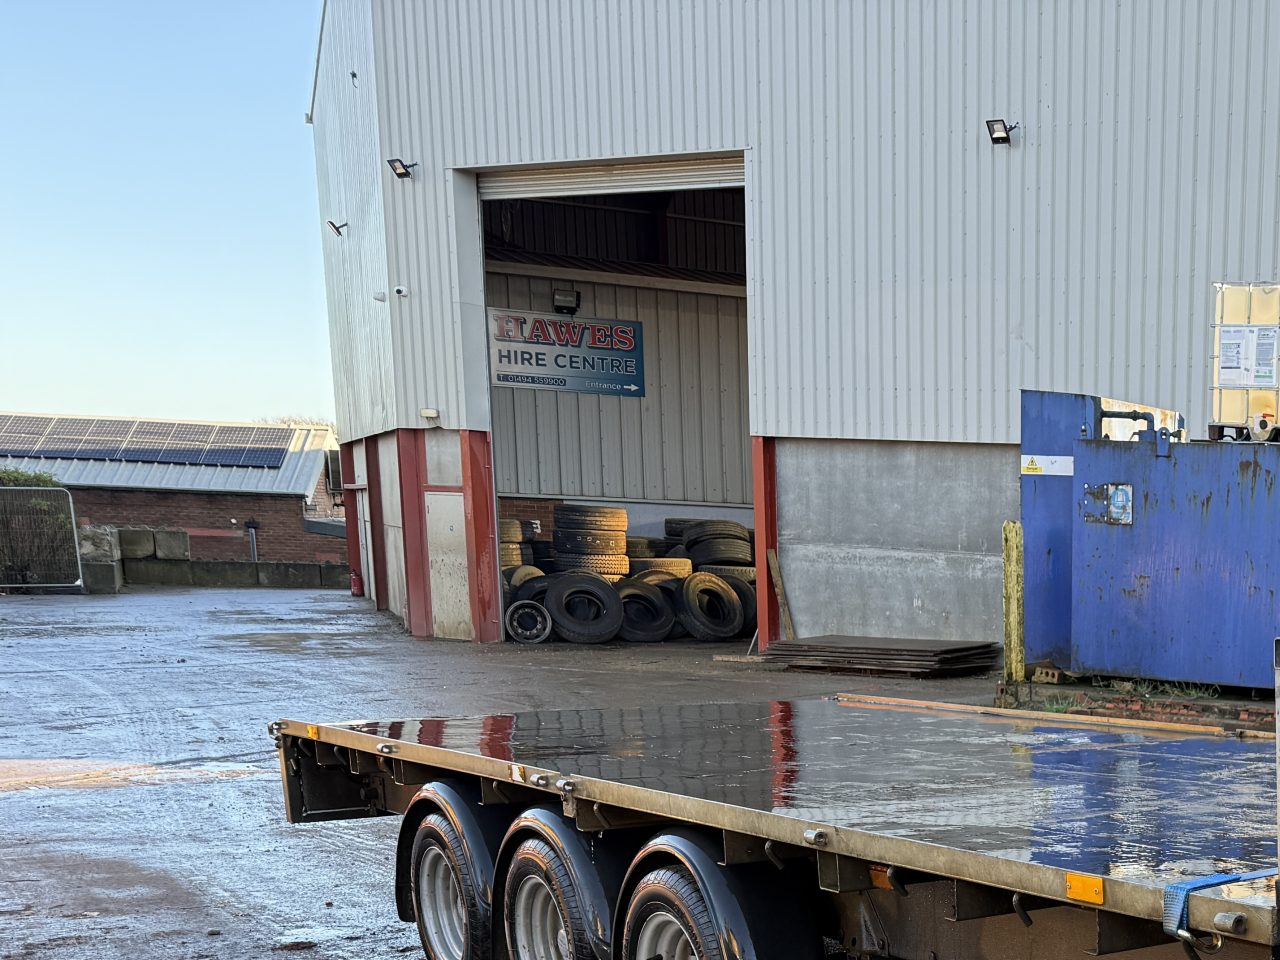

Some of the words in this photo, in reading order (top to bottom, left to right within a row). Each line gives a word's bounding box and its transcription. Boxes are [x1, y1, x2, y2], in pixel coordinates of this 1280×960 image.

[493, 314, 636, 351] HAWES
[498, 349, 547, 367] HIRE
[554, 353, 637, 375] CENTRE
[508, 375, 532, 384] 01494
[534, 377, 566, 386] 559900
[585, 380, 622, 390] Entrance
